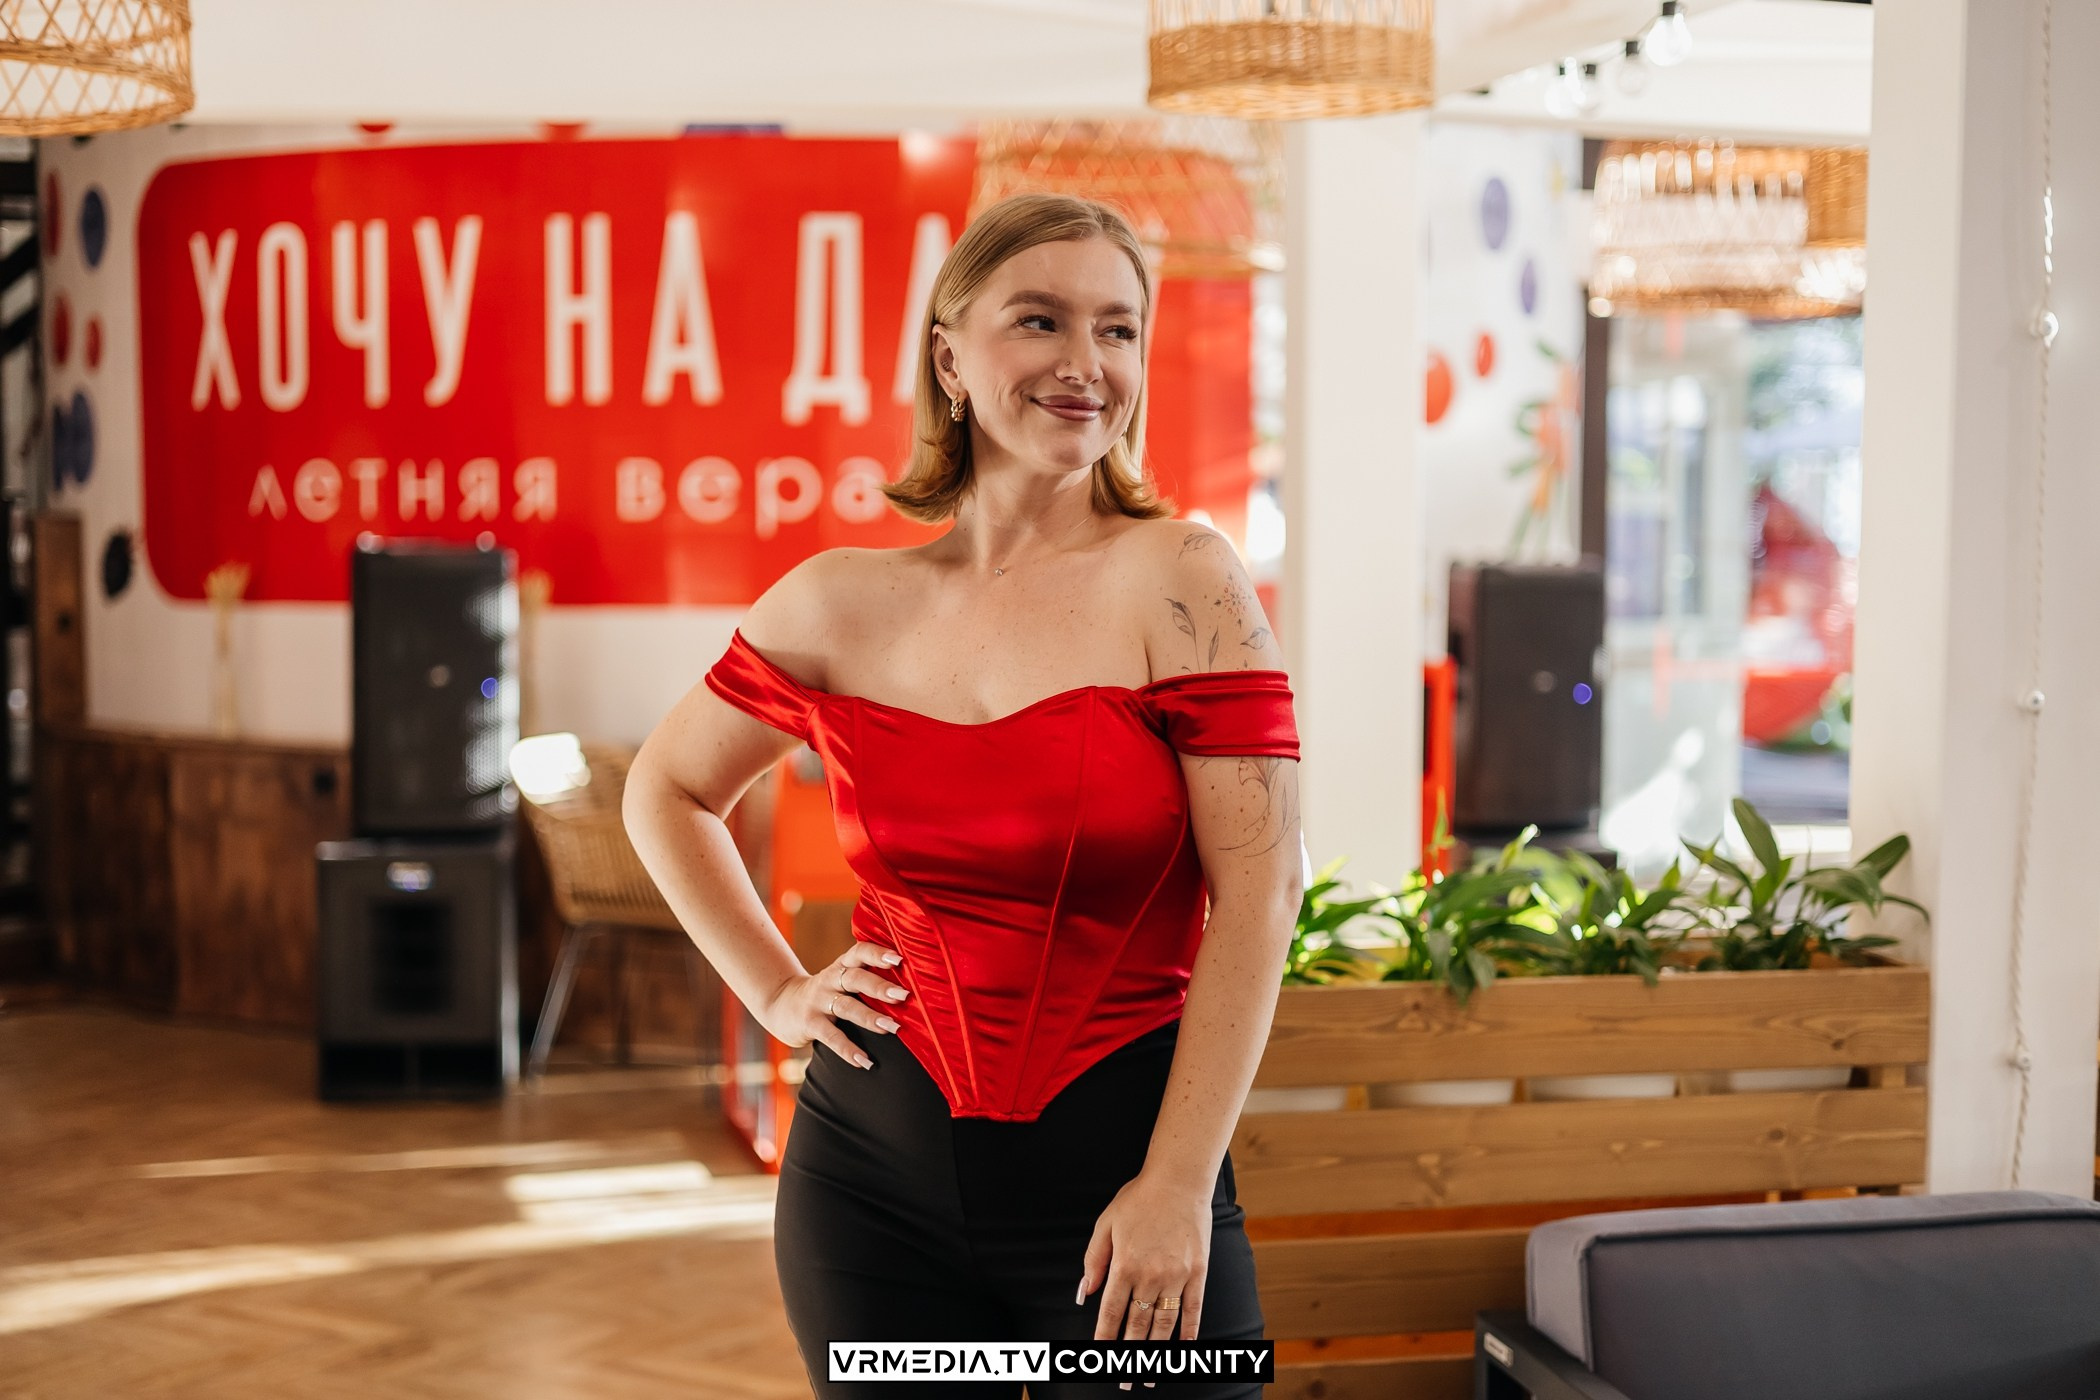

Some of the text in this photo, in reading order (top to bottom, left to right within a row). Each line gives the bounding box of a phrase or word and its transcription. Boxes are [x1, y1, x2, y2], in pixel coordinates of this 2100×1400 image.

[189, 209, 953, 427] ХОЧУ НА ДА
[616, 456, 887, 541] вера
